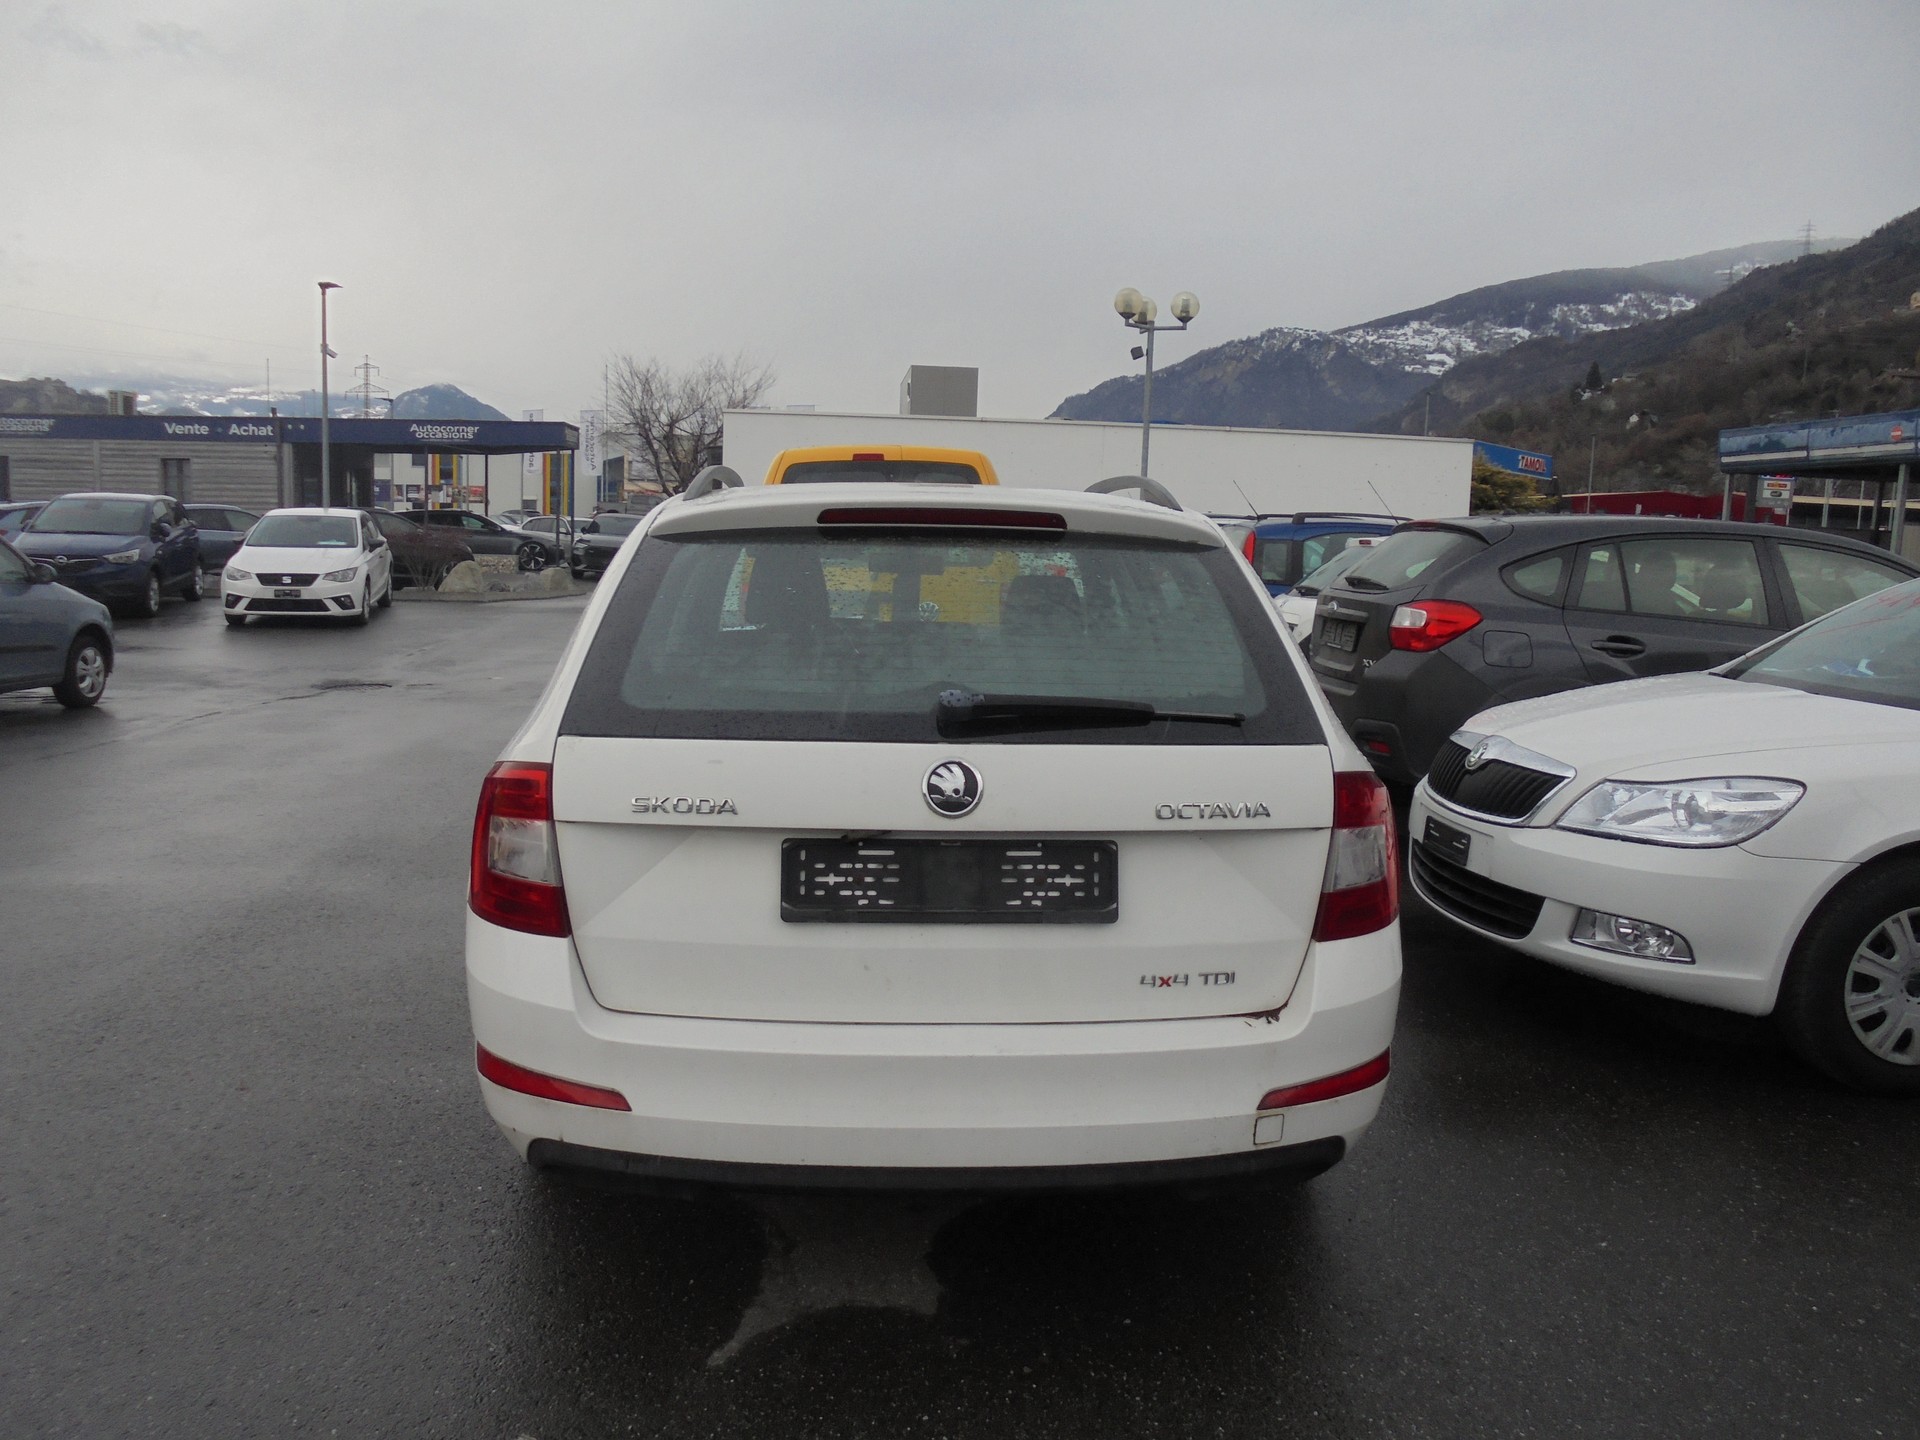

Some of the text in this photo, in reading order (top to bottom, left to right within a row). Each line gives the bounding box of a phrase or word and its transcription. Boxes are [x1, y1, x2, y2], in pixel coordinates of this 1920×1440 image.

[0, 424, 50, 432] ccasions
[164, 422, 274, 436] Vente Achat
[410, 423, 480, 433] Autocorner
[415, 431, 474, 439] occasions
[1519, 455, 1547, 473] TAMOIL
[631, 796, 739, 815] SKODA
[1155, 802, 1271, 820] OCTAVIA
[1139, 971, 1236, 988] 4x4 TDI
